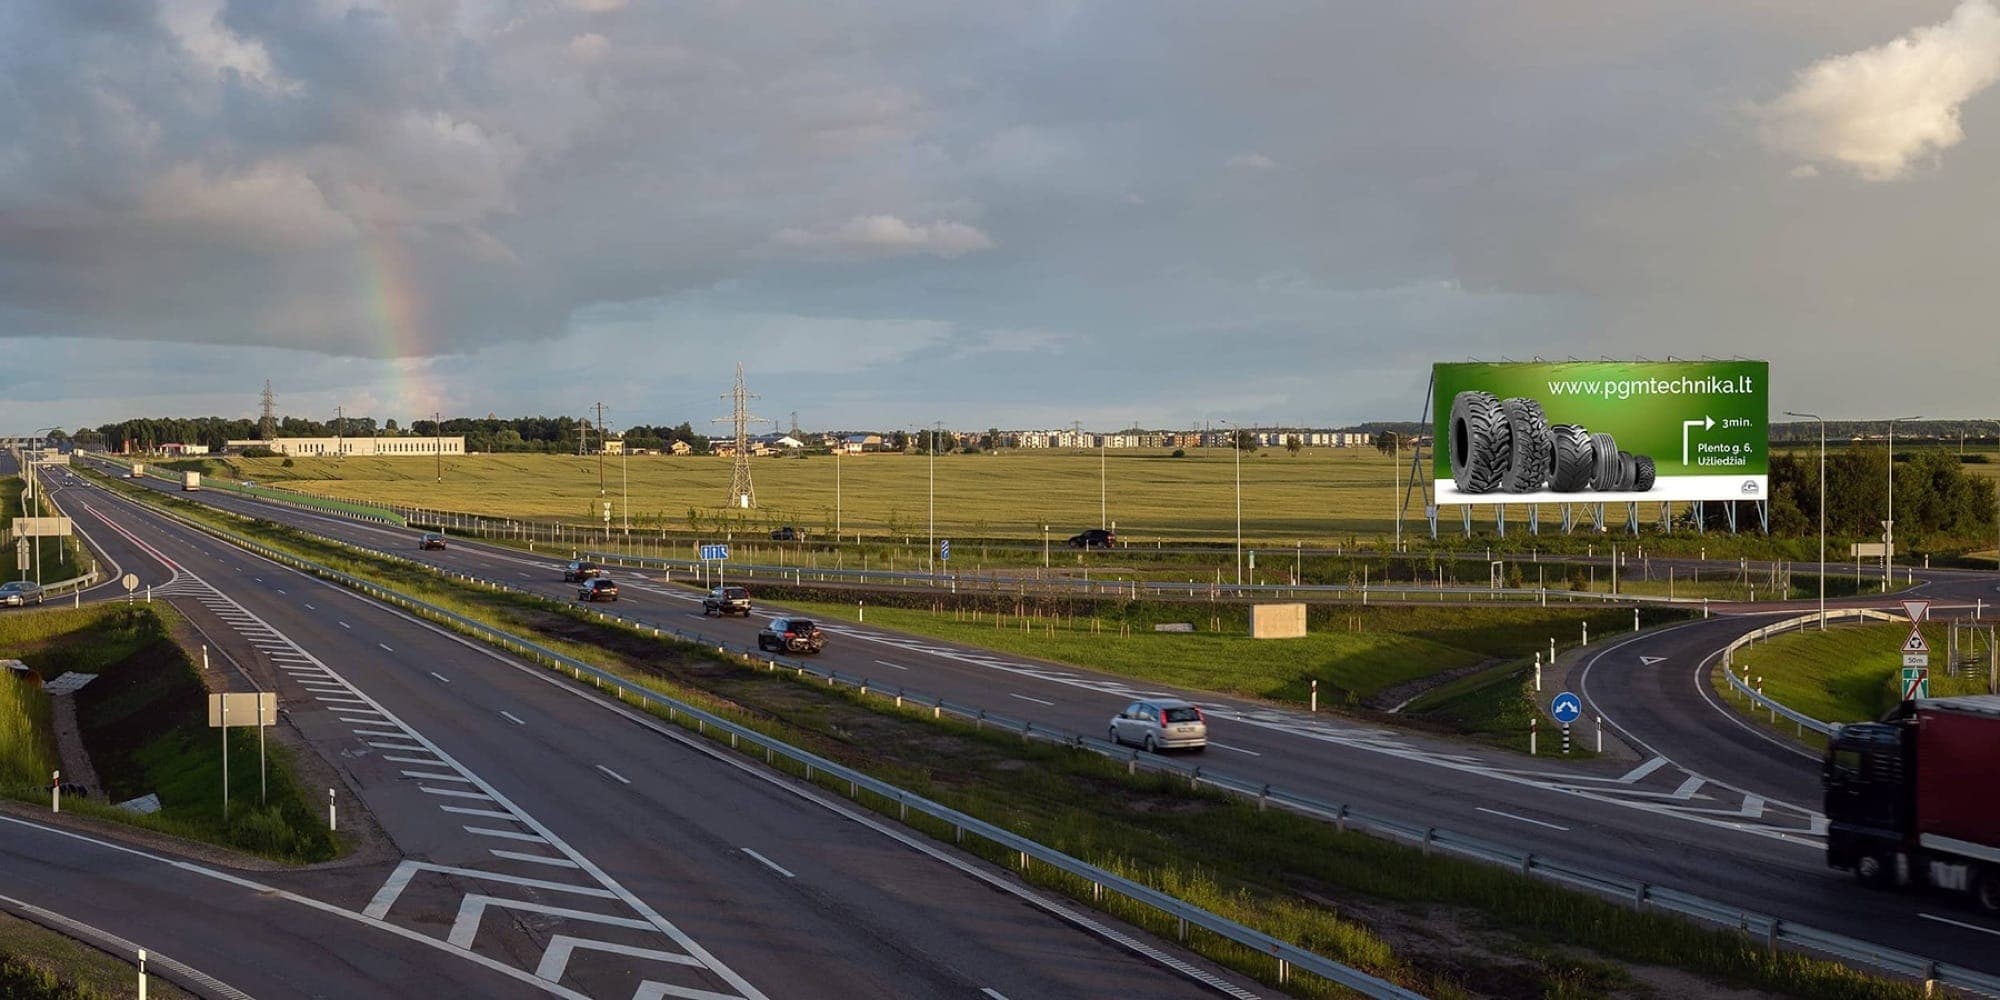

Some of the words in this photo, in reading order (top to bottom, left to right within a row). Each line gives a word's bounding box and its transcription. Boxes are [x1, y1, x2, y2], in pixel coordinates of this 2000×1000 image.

[1548, 376, 1752, 399] www.pgmtechnika.lt
[1722, 417, 1753, 429] 3min.
[1698, 443, 1731, 453] Plento
[1732, 445, 1741, 455] g.
[1698, 456, 1746, 466] Užliedžiai
